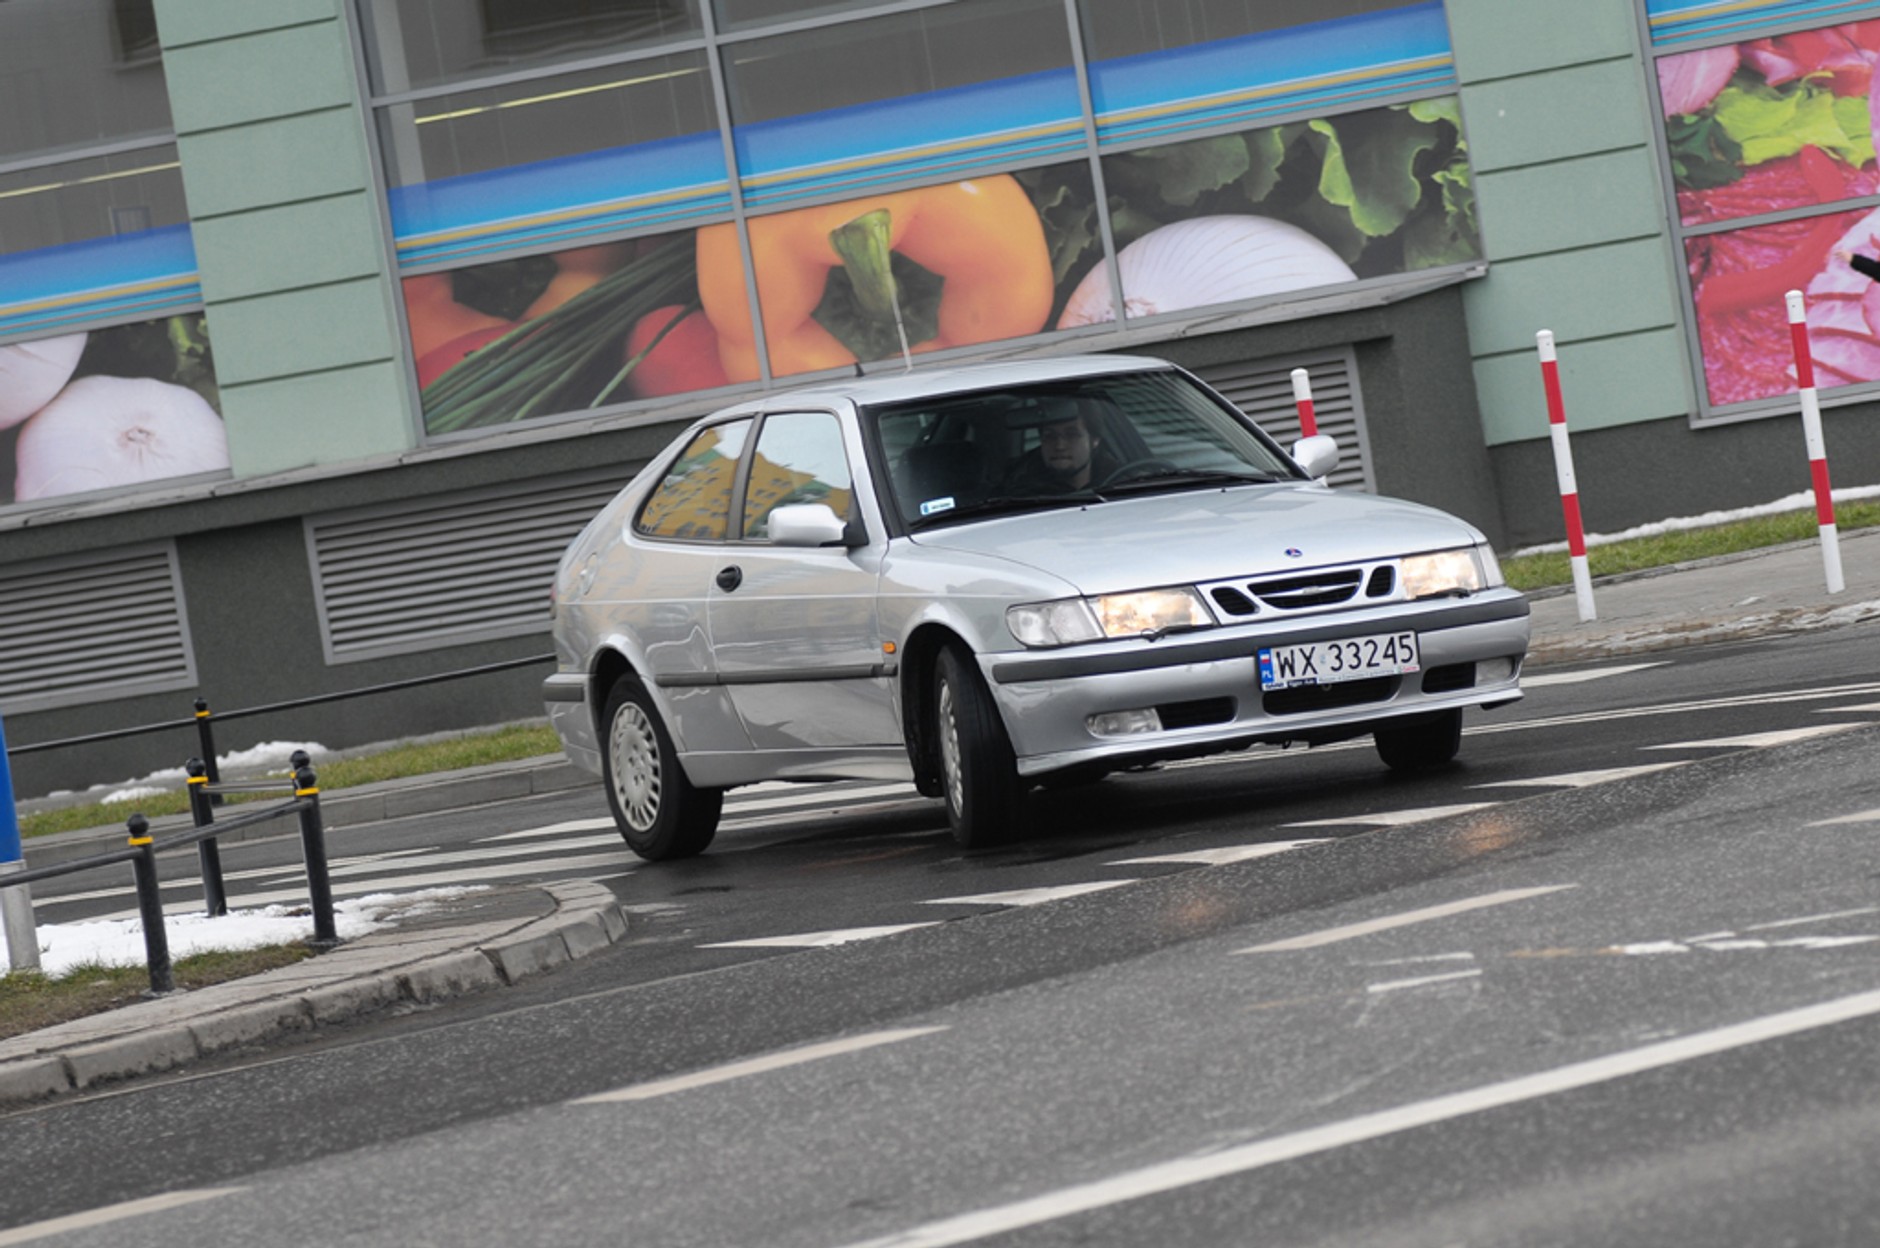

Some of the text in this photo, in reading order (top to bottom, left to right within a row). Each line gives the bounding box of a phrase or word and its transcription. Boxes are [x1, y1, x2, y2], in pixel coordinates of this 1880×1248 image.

[1276, 634, 1414, 678] WX 33245
[1262, 669, 1272, 679] PL
